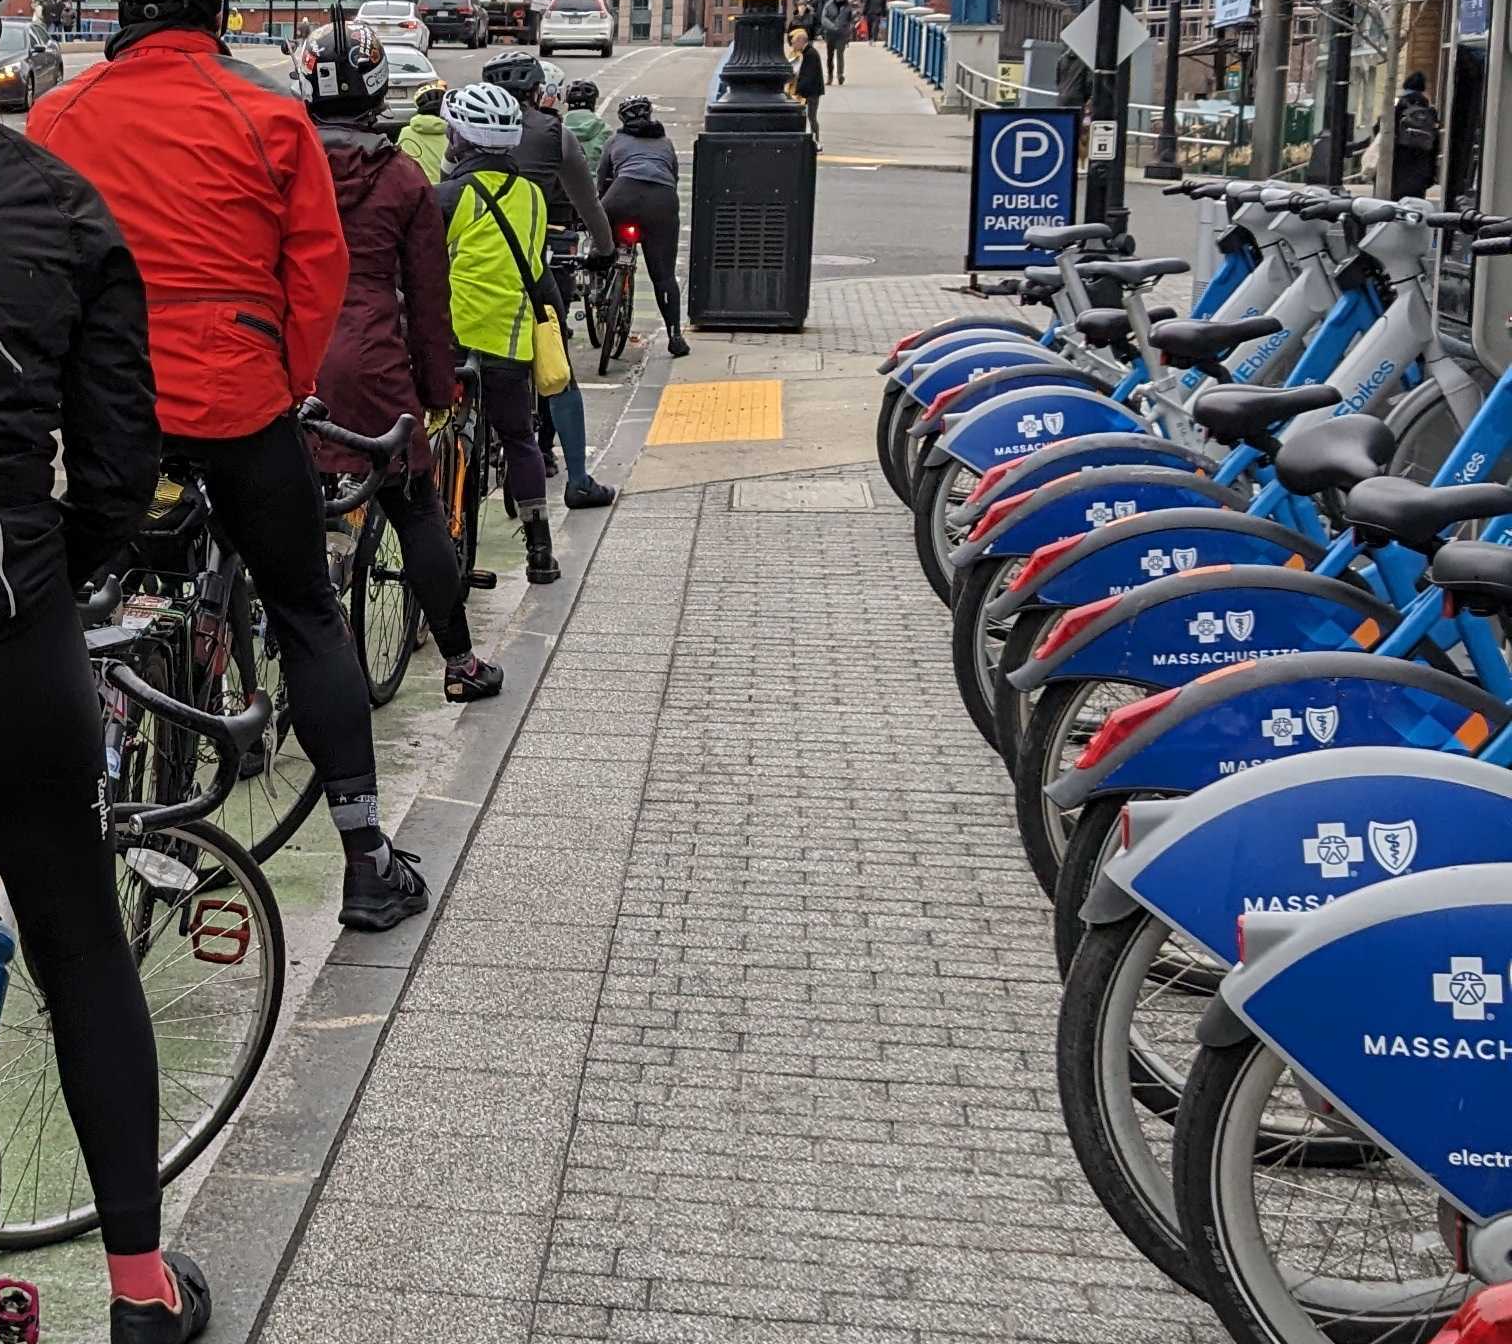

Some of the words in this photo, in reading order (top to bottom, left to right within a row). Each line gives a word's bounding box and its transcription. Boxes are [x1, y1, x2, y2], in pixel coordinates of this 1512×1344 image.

[1014, 131, 1049, 175] P
[992, 194, 1059, 209] PUBLIC
[984, 215, 1065, 230] PARKING
